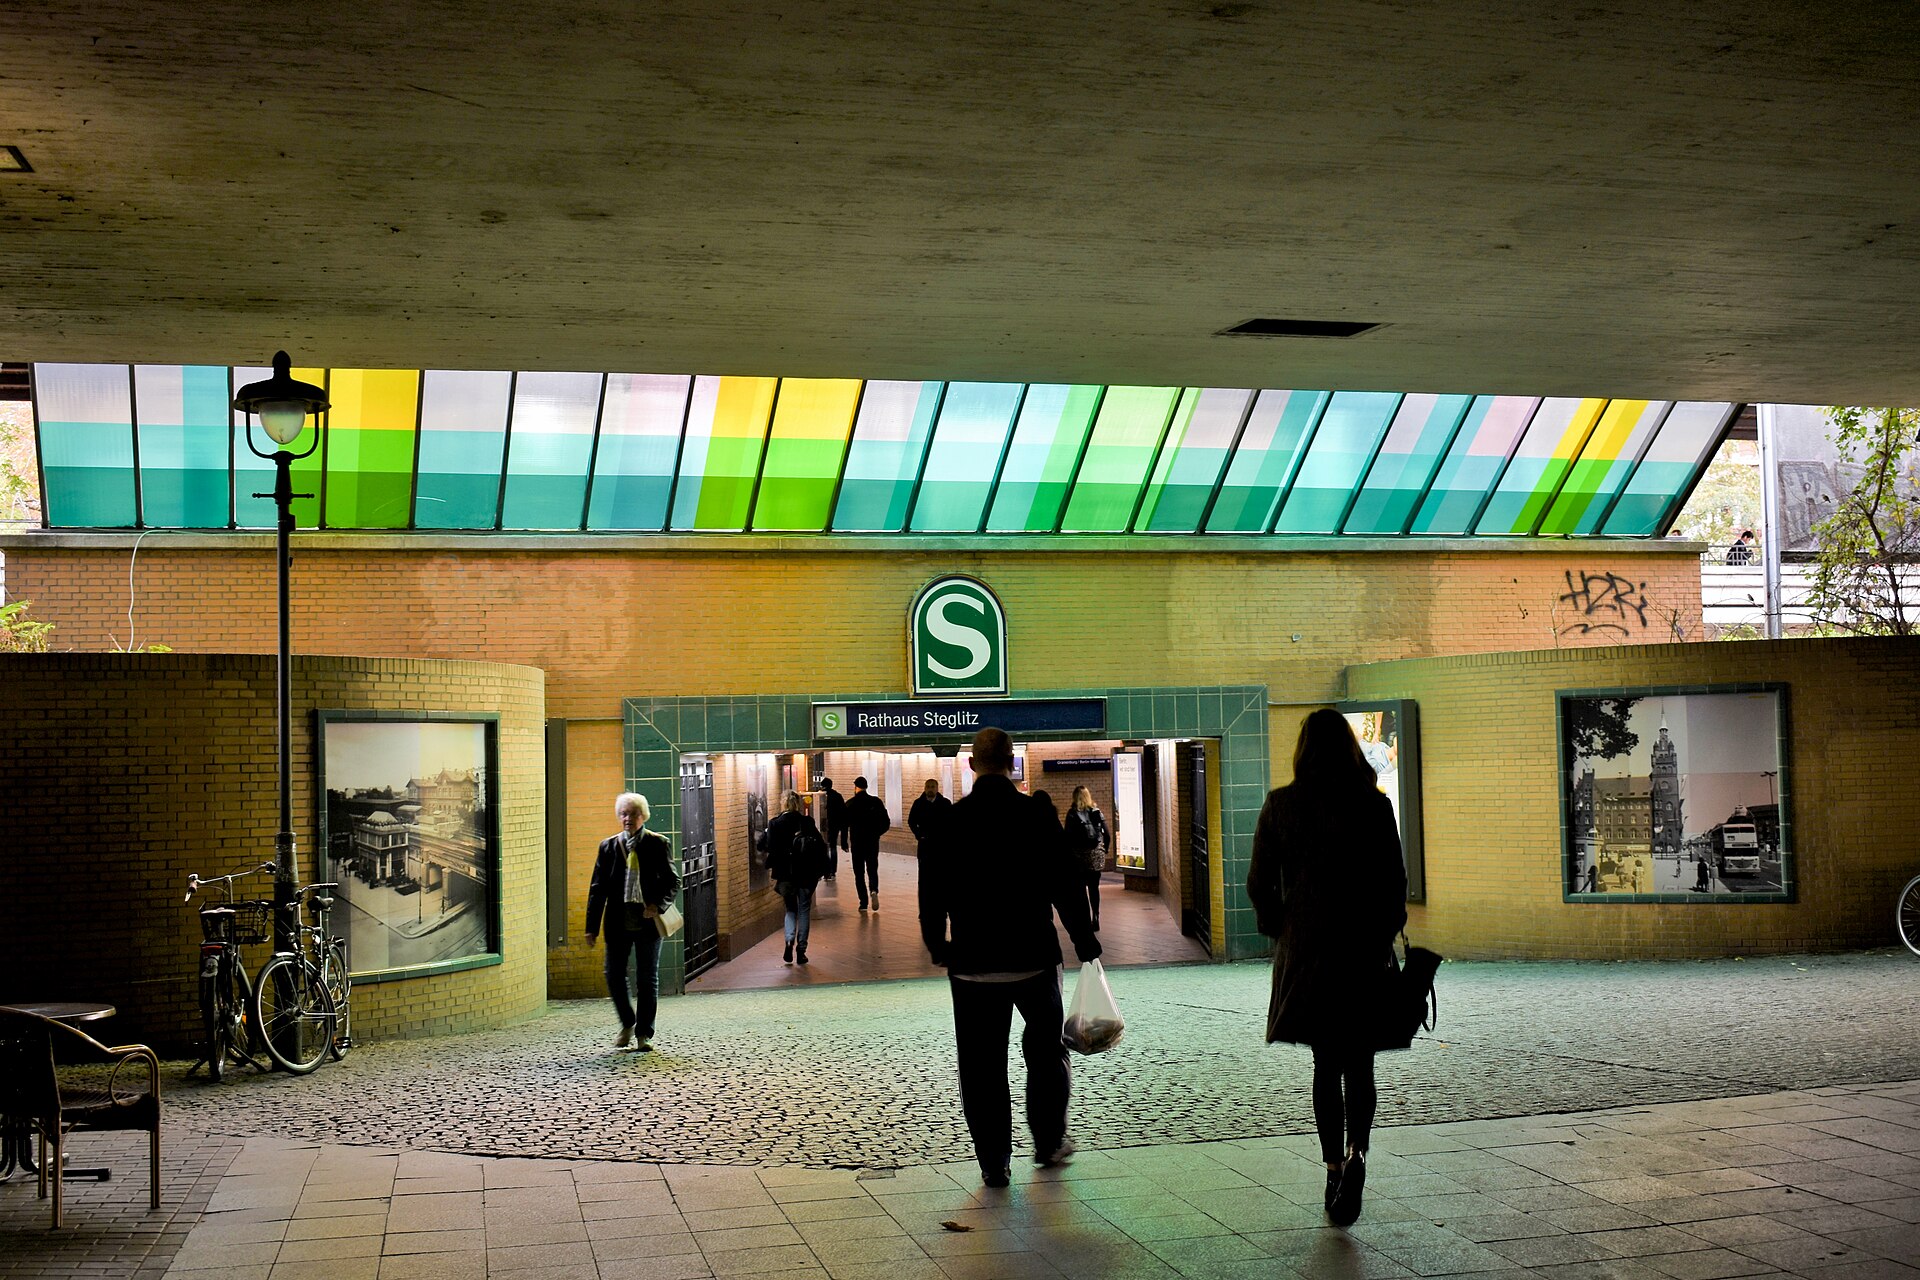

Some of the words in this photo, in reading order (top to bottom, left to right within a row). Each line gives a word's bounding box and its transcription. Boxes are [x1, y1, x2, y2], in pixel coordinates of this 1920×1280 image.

[926, 593, 991, 680] S
[824, 714, 838, 729] S
[858, 713, 919, 728] Rathaus
[923, 711, 979, 728] Steglitz
